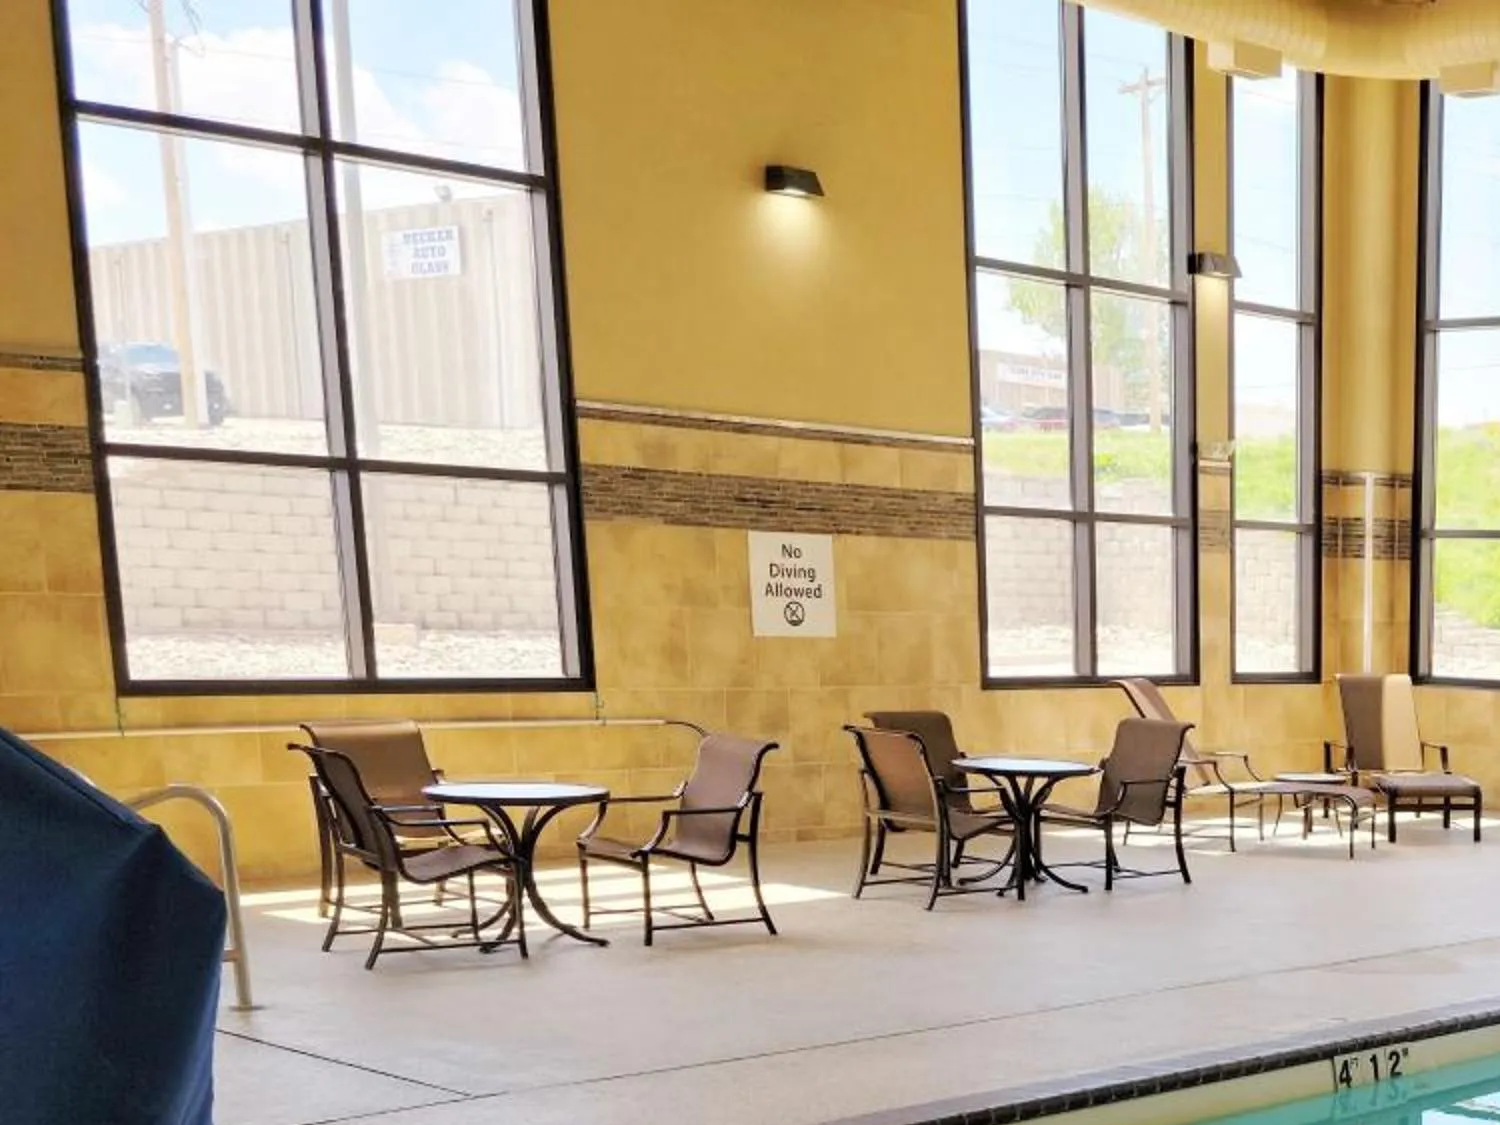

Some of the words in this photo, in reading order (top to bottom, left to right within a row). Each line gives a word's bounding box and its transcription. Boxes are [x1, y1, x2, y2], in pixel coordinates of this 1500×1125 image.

[781, 544, 802, 559] No
[769, 562, 817, 583] Diving
[765, 582, 823, 599] Allowed
